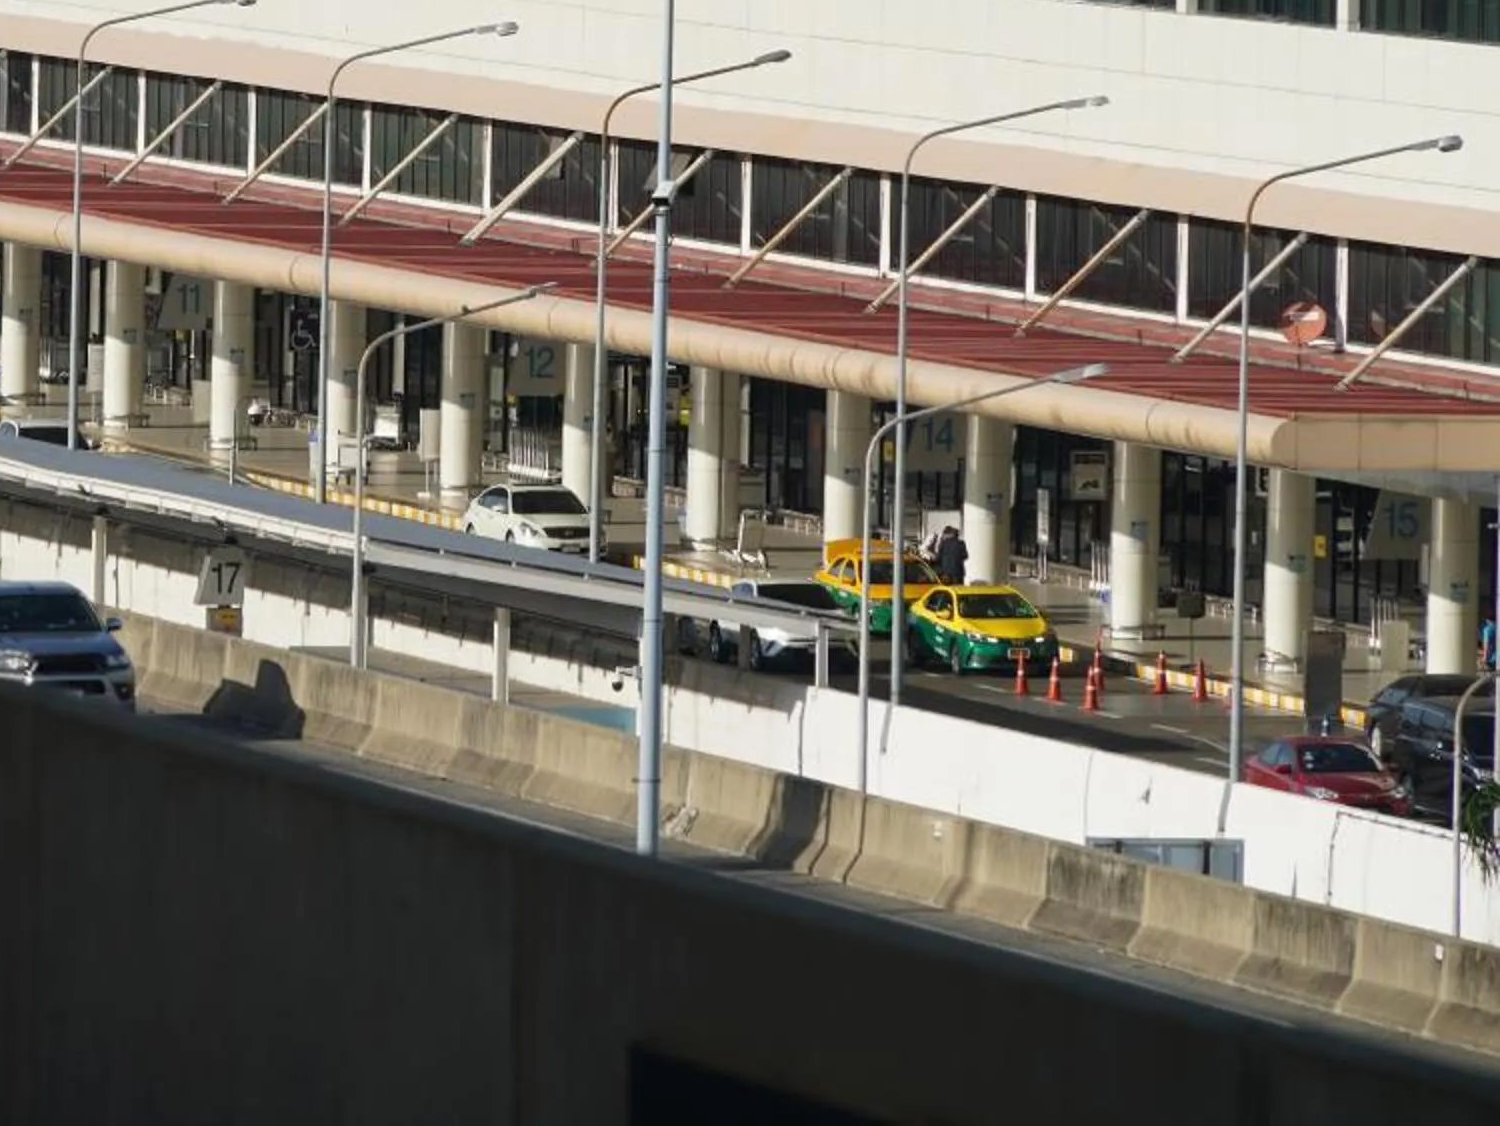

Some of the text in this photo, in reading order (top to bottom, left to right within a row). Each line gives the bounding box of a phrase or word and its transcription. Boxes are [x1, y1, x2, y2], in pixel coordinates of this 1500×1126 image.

[177, 283, 201, 314] 11
[524, 345, 555, 379] 12
[921, 417, 955, 453] 14
[1384, 501, 1418, 538] 15
[211, 562, 243, 595] 17
